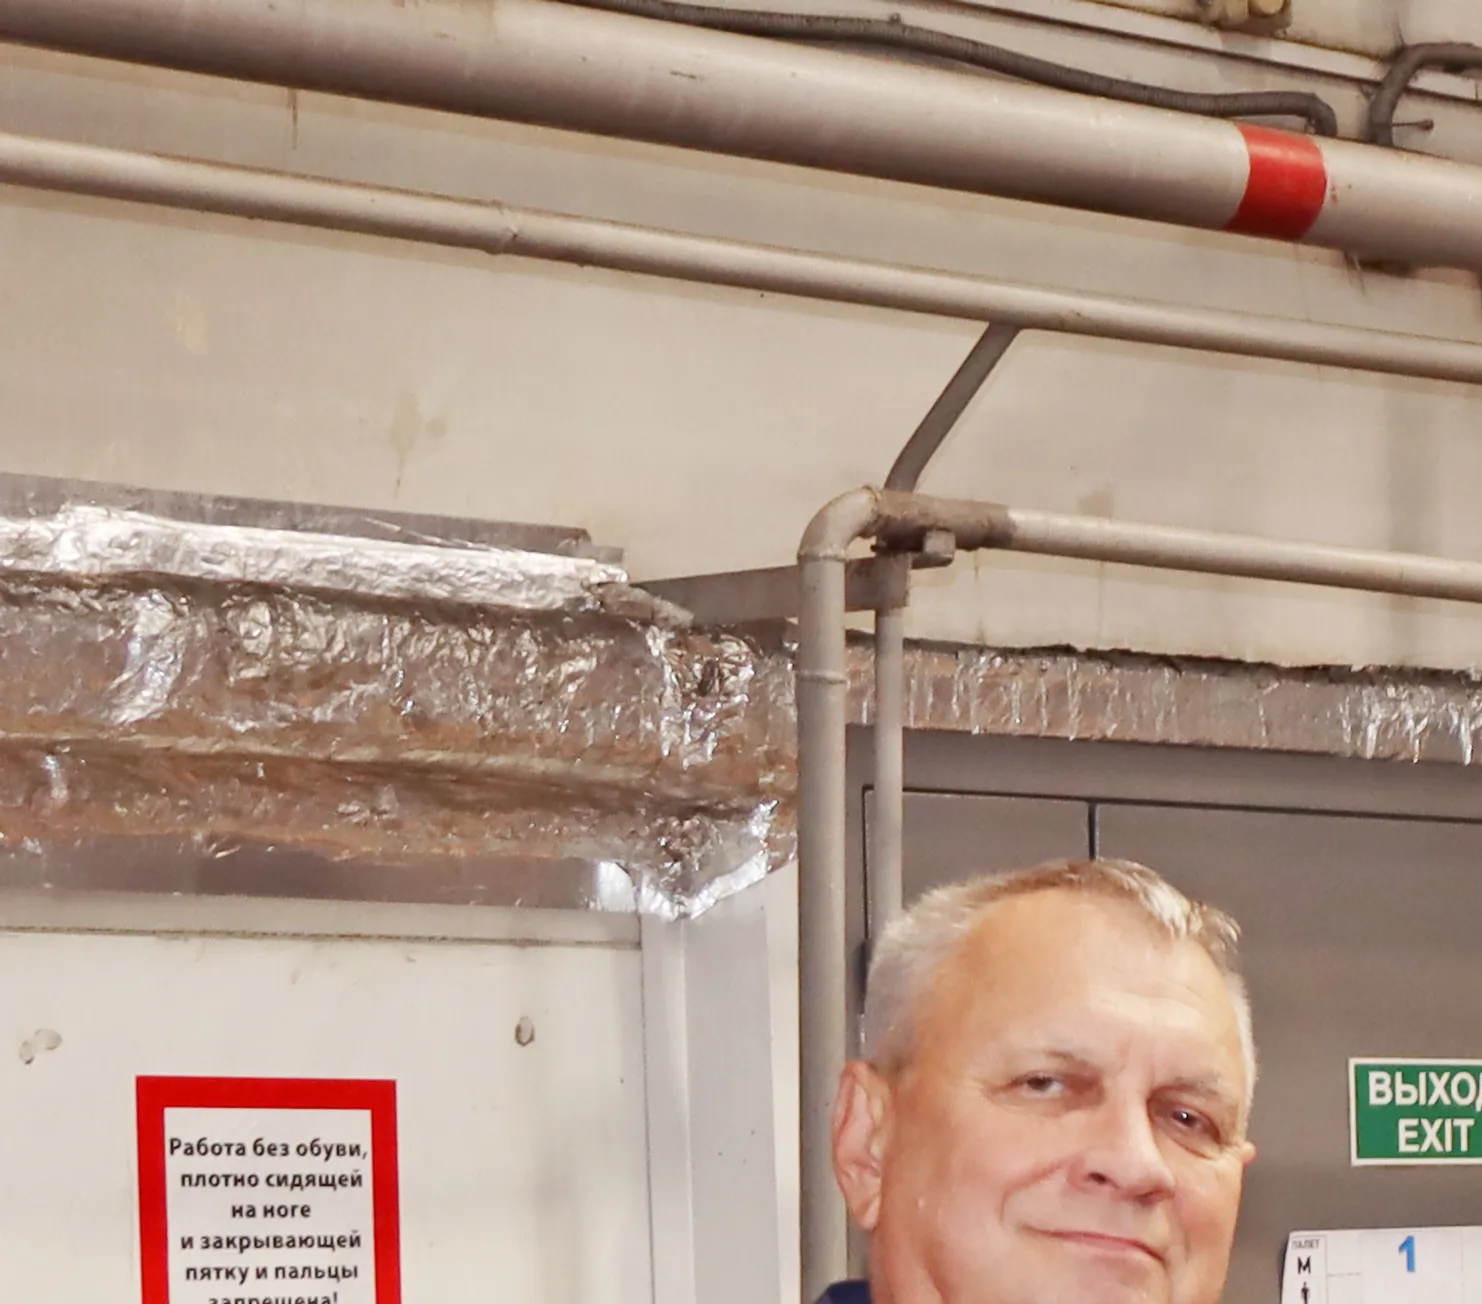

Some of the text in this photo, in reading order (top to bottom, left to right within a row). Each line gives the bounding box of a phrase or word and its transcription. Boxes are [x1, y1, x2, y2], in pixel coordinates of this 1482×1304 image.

[1398, 1118, 1476, 1153] EXIT
[169, 1138, 368, 1162] Работа без обуви,
[180, 1168, 363, 1191] плотно сидящей
[231, 1204, 312, 1218] на ноге
[181, 1230, 362, 1254] и закрывающей
[1297, 1255, 1311, 1275] М
[1398, 1235, 1416, 1273] 1
[186, 1264, 359, 1285] пятку и пальцы
